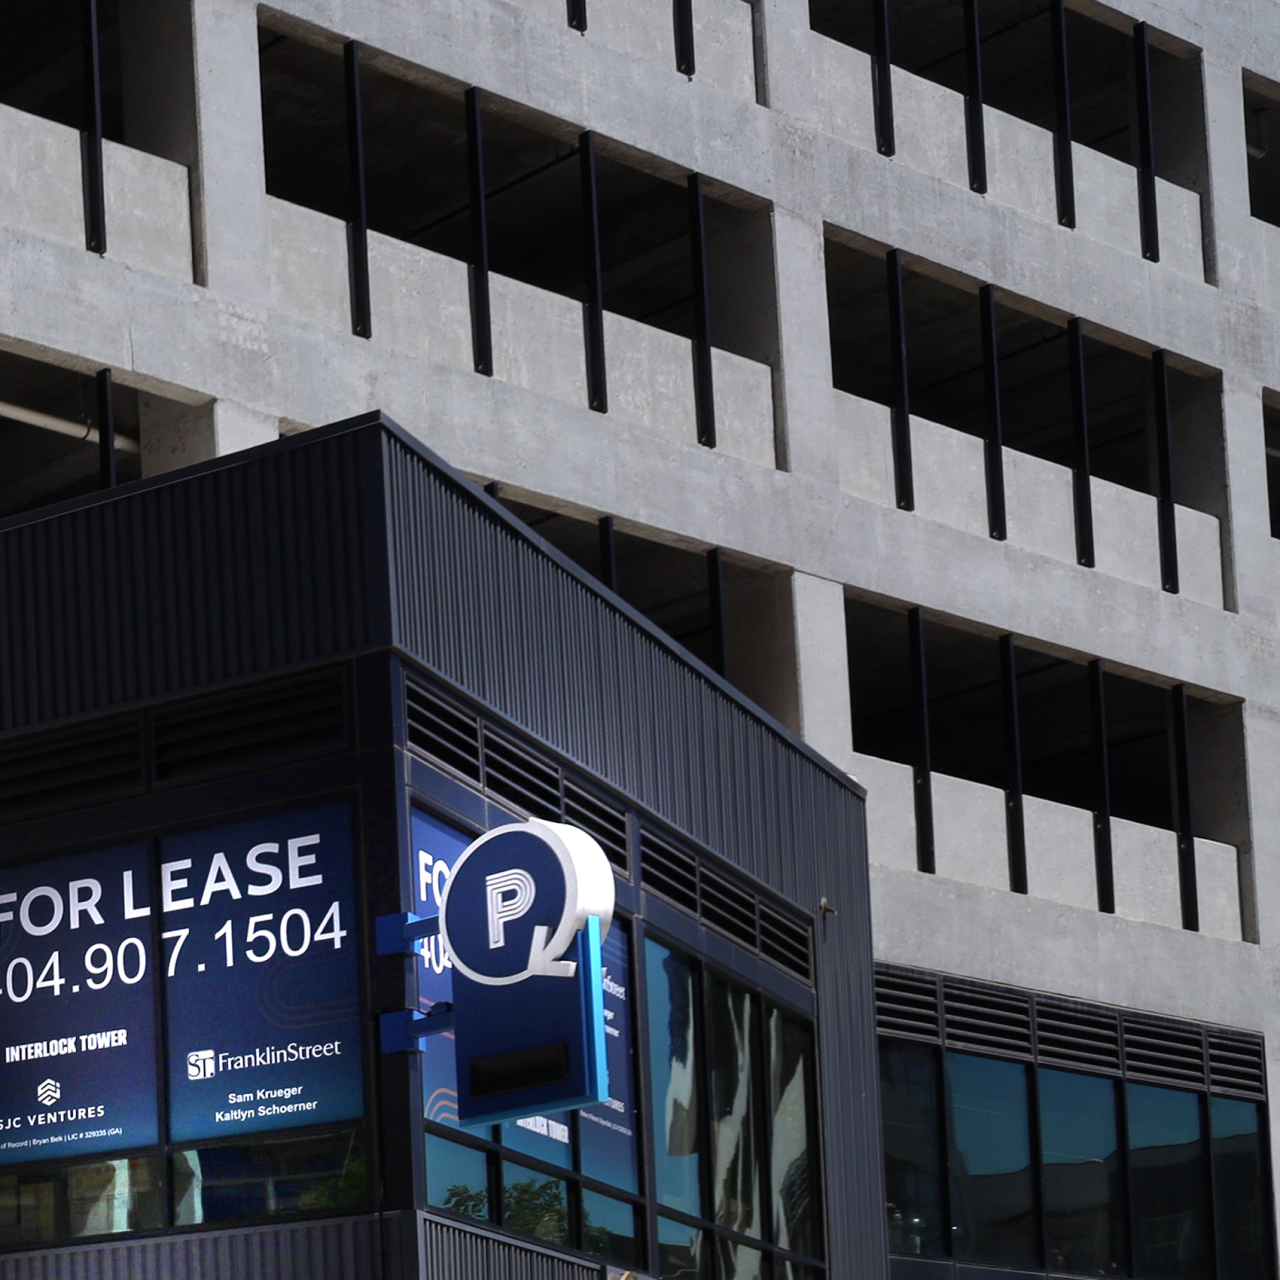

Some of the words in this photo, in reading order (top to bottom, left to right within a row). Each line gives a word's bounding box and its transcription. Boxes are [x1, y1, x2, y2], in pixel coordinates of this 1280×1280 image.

[122, 833, 324, 920] LEASE
[485, 868, 536, 950] P
[5, 1036, 77, 1063] INTERLOCK
[79, 1028, 128, 1052] TOWER
[218, 1040, 342, 1072] FranklinStreet
[228, 1092, 254, 1104] Sam
[256, 1085, 304, 1101] Krueger
[27, 1105, 106, 1127] VENTURES
[215, 1108, 255, 1123] Kaitlyn
[257, 1100, 318, 1117] Schoerner
[7, 1139, 28, 1149] Record
[32, 1136, 50, 1146] Bryan
[50, 1135, 63, 1144] Belk
[107, 1127, 123, 1137] (GA)
